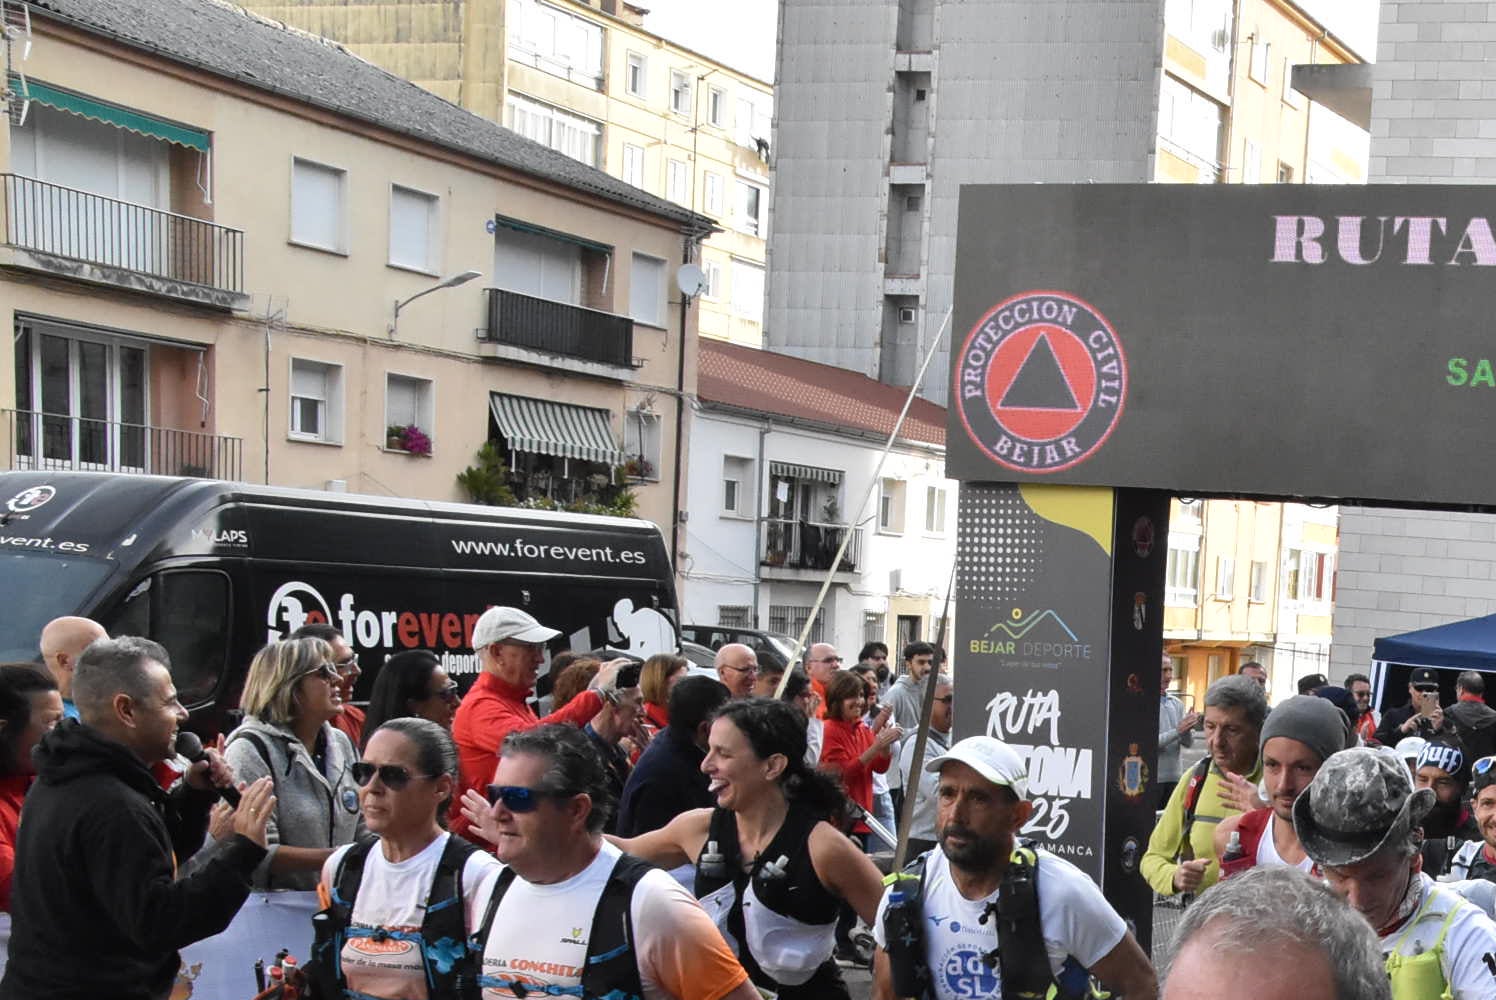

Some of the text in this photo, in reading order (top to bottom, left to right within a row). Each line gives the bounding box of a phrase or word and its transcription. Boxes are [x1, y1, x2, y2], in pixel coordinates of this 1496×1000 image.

[964, 300, 1120, 409] PROTECCION CIVIL
[993, 435, 1082, 467] BEJAR
[451, 538, 647, 565] www.forevent.es
[339, 593, 482, 650] foreven
[1023, 641, 1092, 660] DEPORTE
[985, 689, 1060, 746] RUTA
[1020, 797, 1071, 840] 25
[1036, 842, 1093, 857] AMANCA
